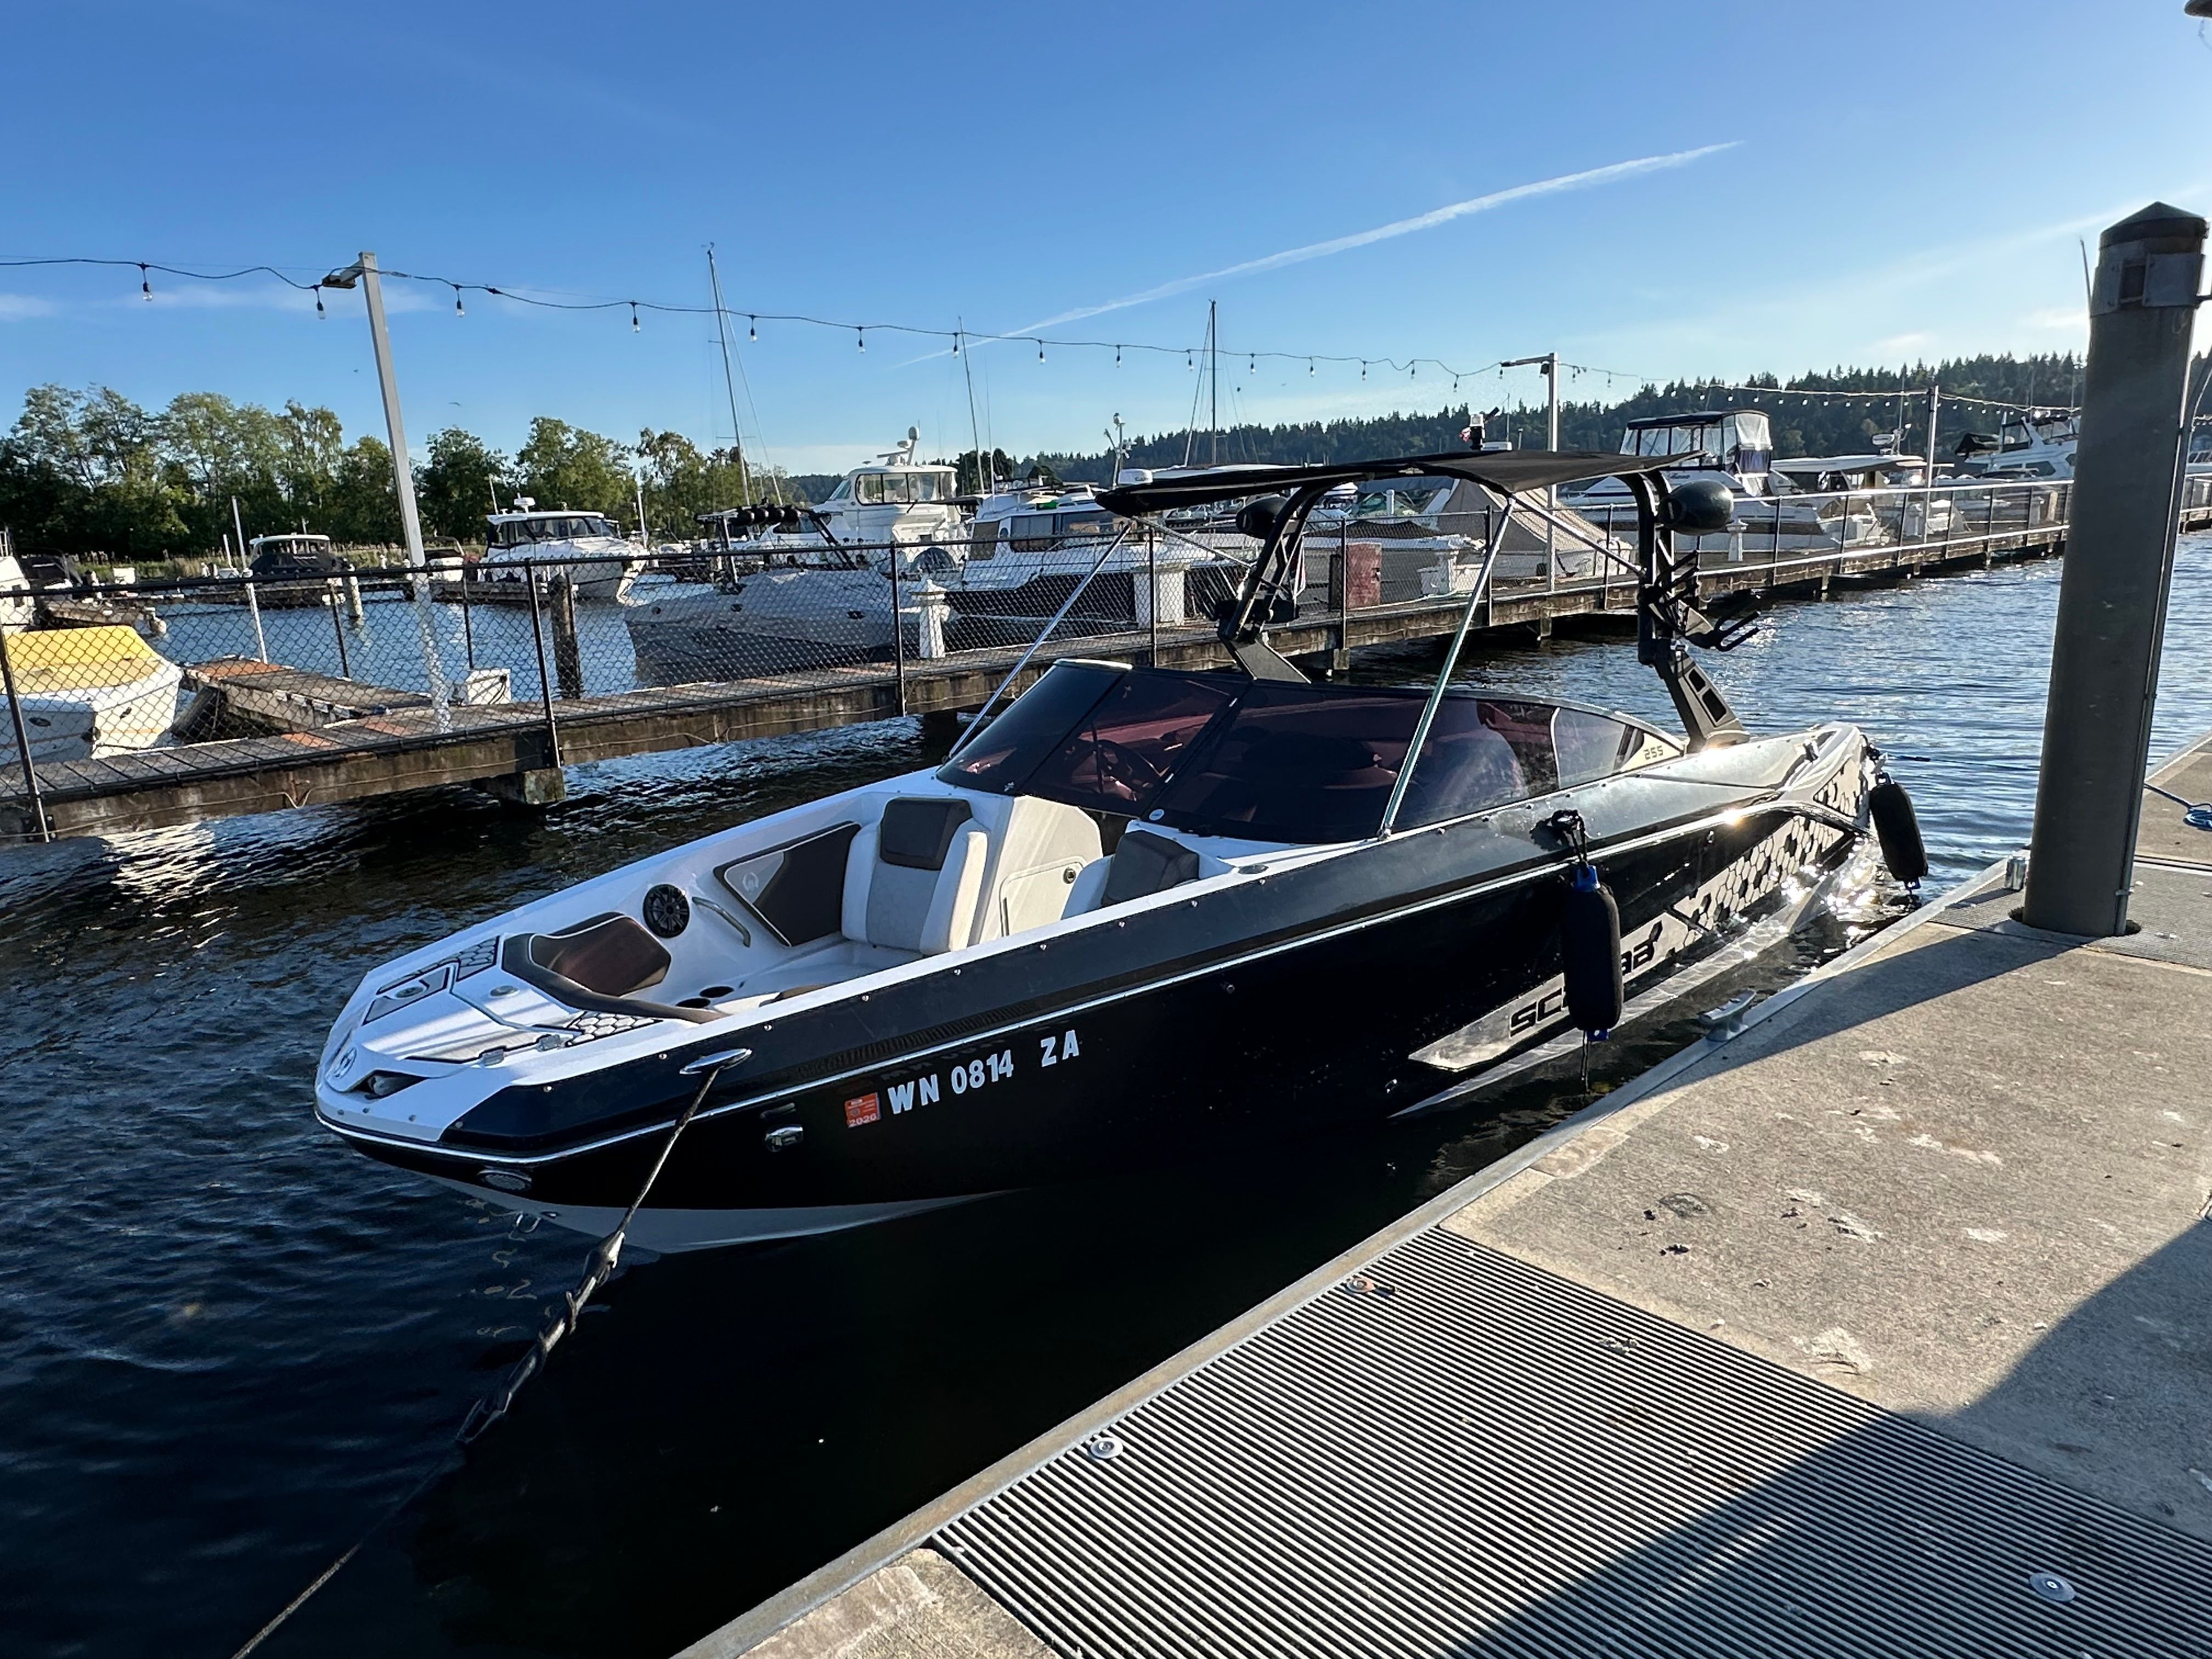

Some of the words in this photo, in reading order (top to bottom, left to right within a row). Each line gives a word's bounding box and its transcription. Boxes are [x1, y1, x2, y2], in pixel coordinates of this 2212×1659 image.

[1643, 745, 1663, 760] 255
[888, 1073, 939, 1114] WN
[951, 1049, 1014, 1094] 0814
[1040, 1029, 1080, 1067] ZA
